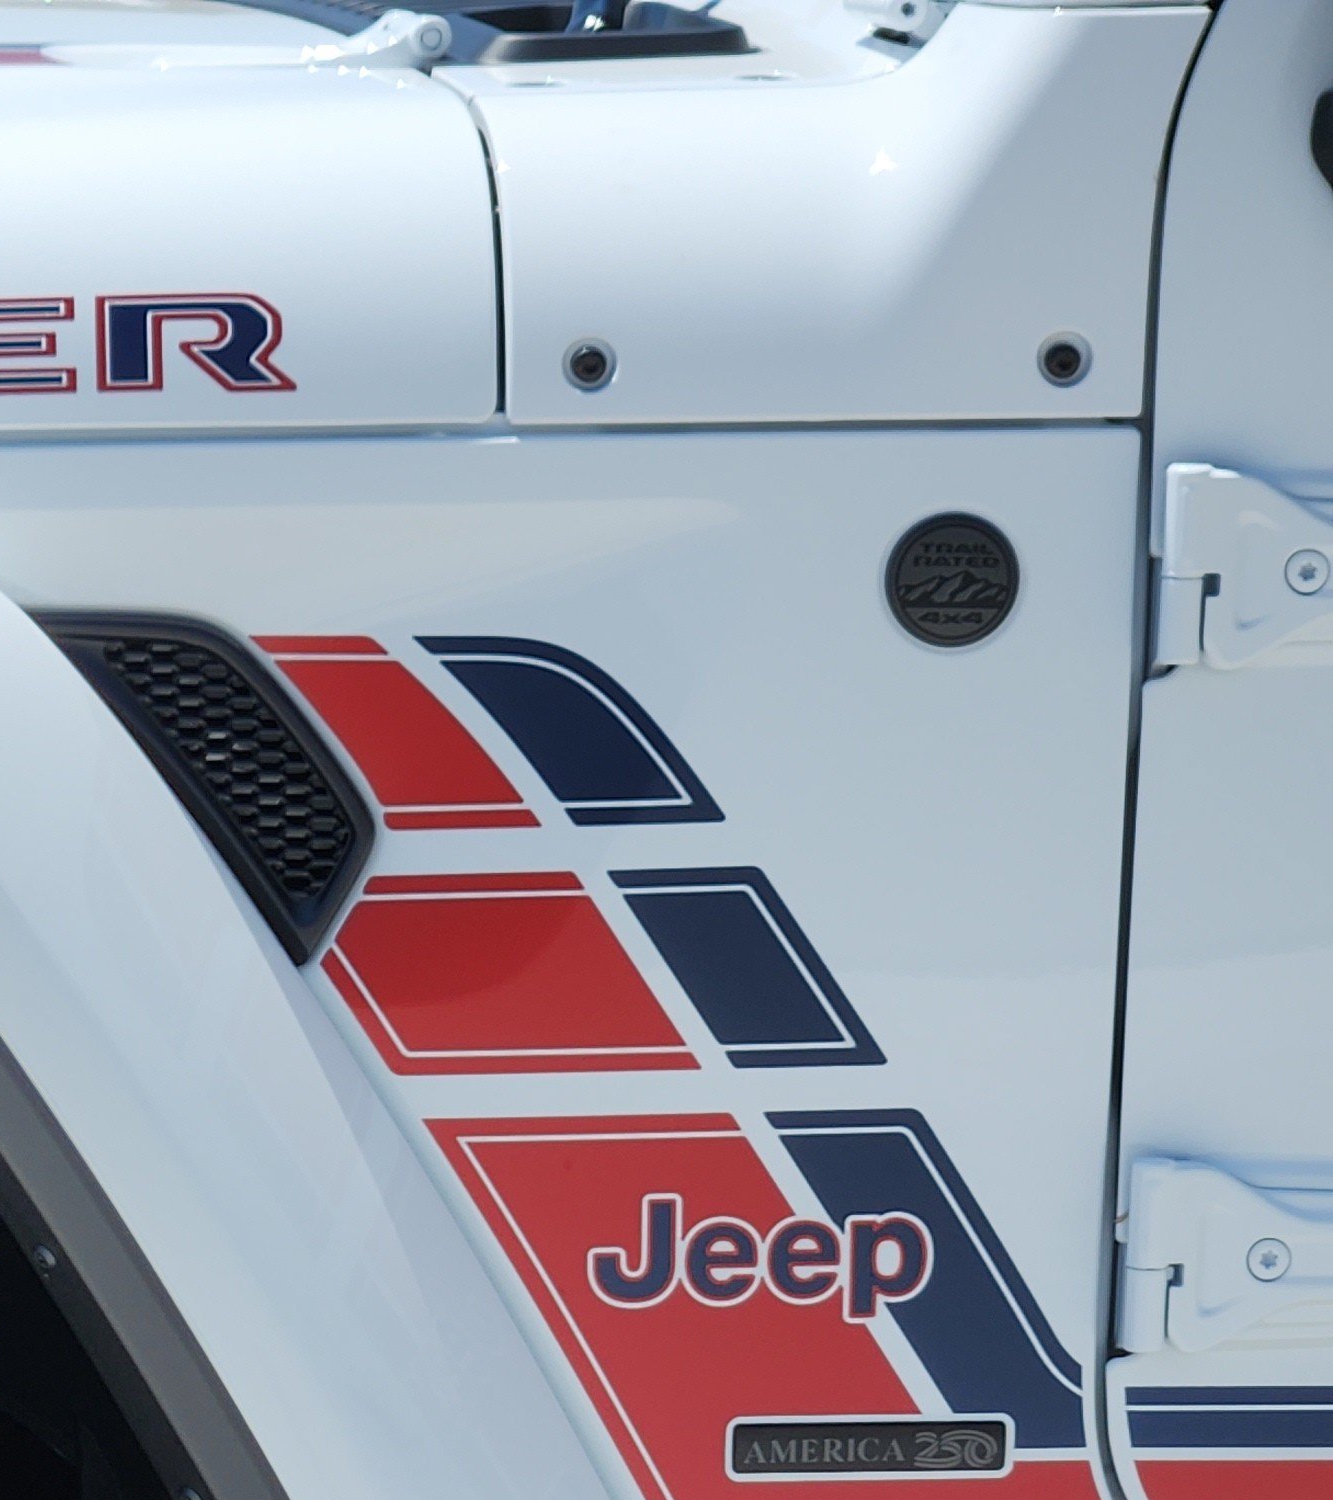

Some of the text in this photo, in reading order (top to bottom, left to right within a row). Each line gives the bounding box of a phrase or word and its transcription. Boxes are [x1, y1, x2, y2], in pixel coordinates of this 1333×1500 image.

[920, 542, 994, 554] TRAIL
[913, 555, 1000, 568] RATED
[917, 611, 983, 623] 4x4
[588, 1194, 934, 1321] Jeep
[742, 1429, 998, 1468] AMERICA 250
